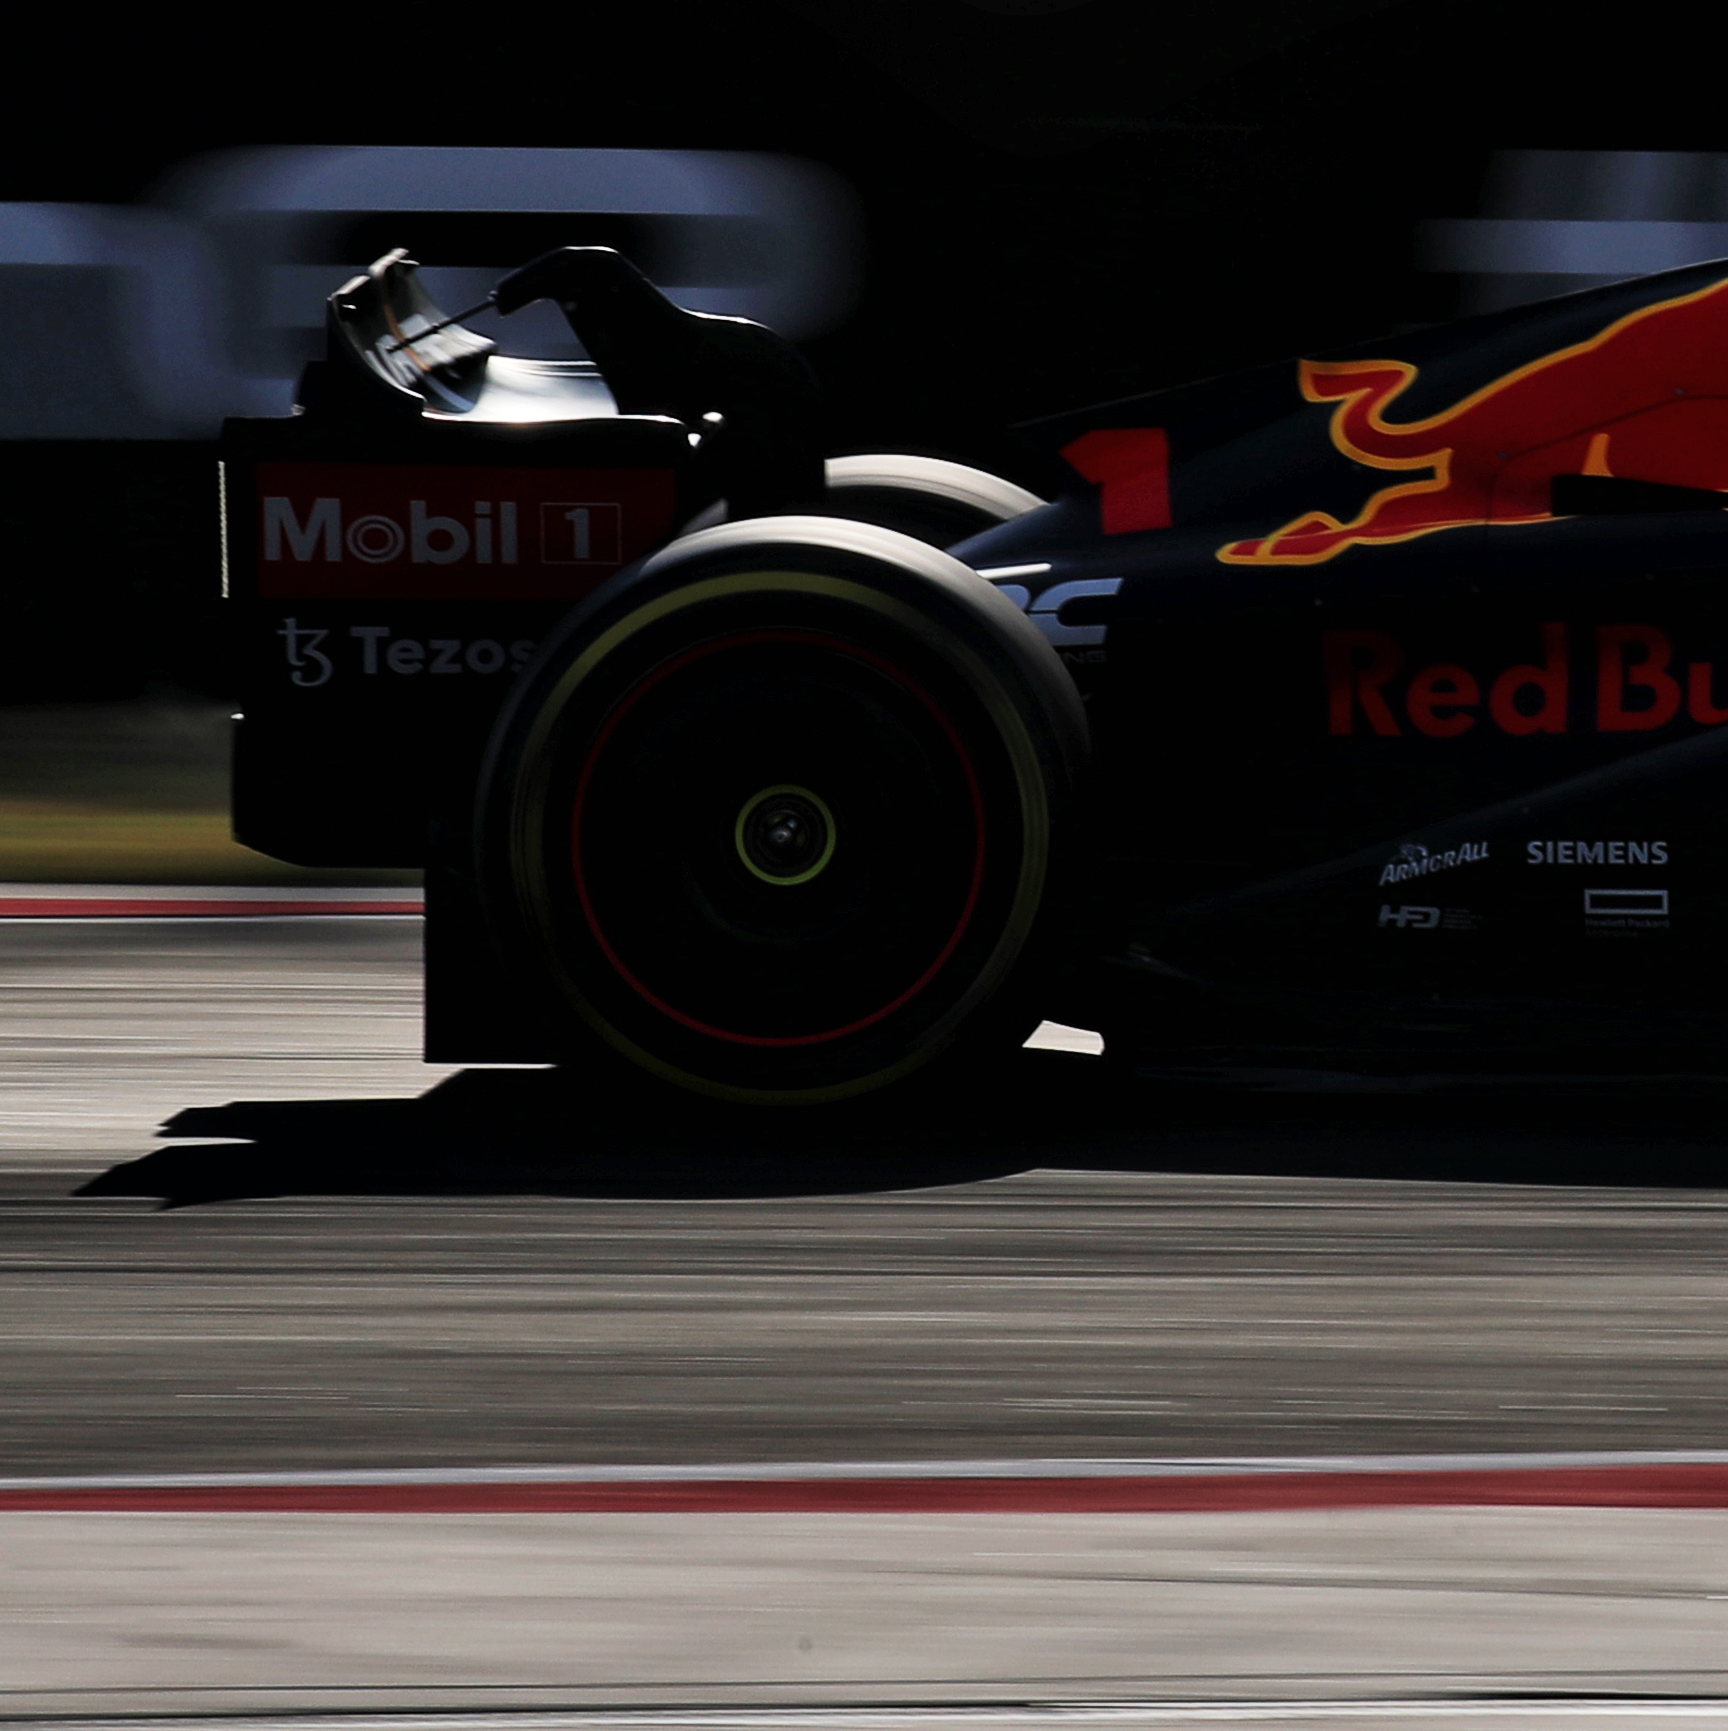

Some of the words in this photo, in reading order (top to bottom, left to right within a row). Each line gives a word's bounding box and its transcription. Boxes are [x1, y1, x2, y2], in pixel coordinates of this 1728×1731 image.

[1058, 426, 1173, 536] 1
[263, 496, 518, 565] Mobil
[563, 508, 592, 559] 1
[349, 625, 536, 676] Tezos
[1321, 620, 1571, 738] Red
[1526, 840, 1669, 865] SIEMENS
